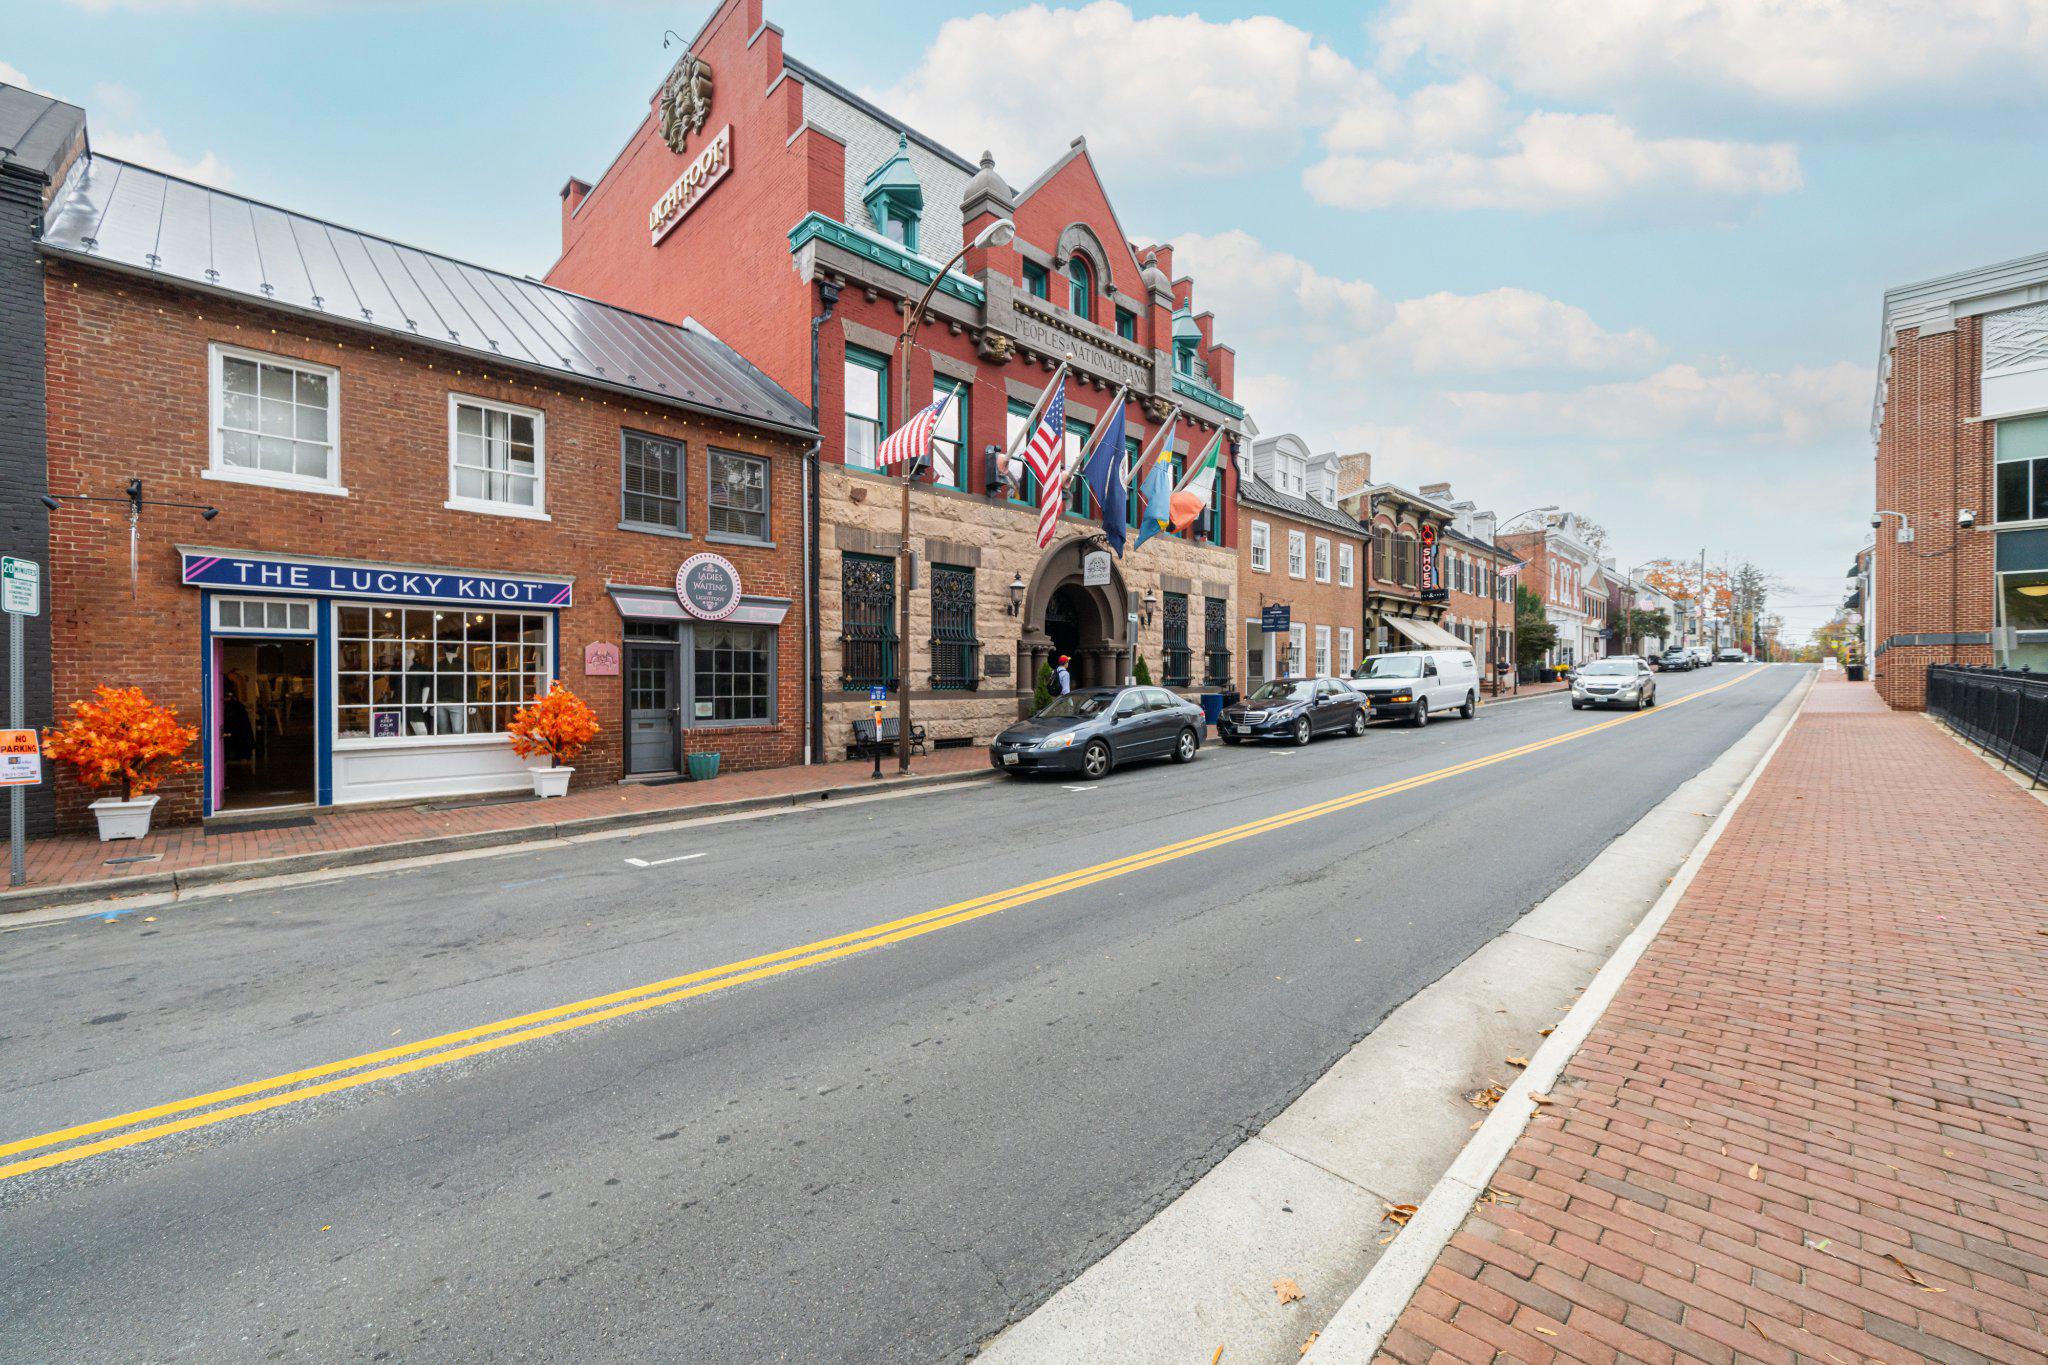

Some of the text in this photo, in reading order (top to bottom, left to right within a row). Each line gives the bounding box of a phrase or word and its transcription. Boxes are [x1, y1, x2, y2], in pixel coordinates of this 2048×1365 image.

[649, 138, 725, 232] LIGHTFOOT
[1015, 317, 1148, 387] PEOPLES NATIONAL BANK
[4, 563, 37, 576] 20 MINUTES
[1423, 548, 1431, 588] SHOES
[233, 562, 537, 600] THE LUCKY KNOT
[698, 572, 723, 582] LADIES
[693, 580, 727, 592] WAITING
[15, 735, 27, 743] NO
[0, 745, 37, 753] PARKING
